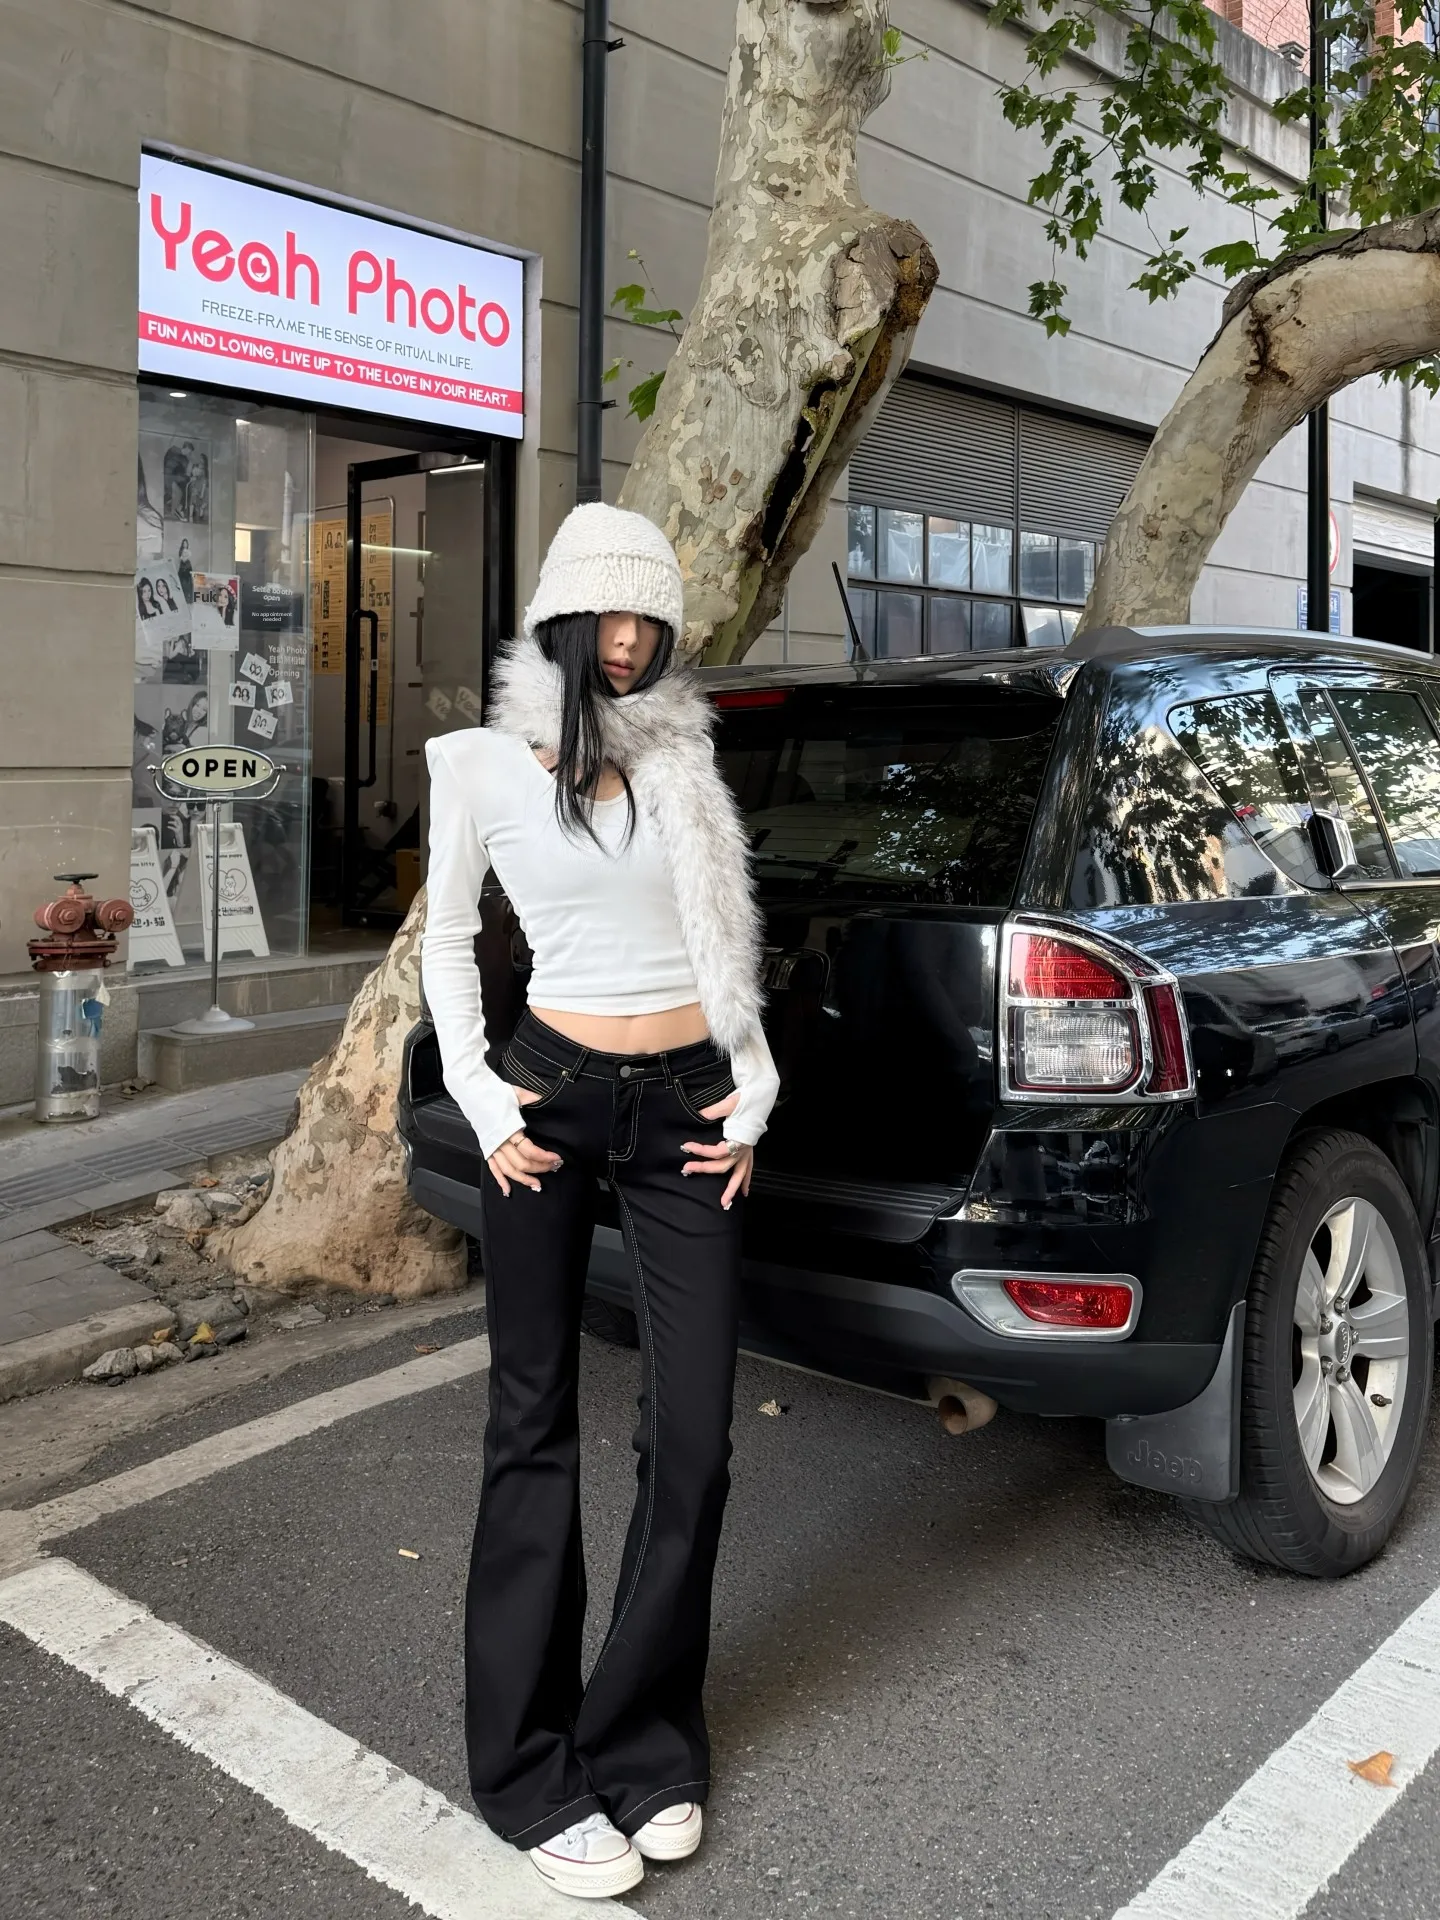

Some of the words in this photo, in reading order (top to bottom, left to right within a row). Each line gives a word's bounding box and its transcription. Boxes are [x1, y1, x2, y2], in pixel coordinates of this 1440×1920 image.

[150, 193, 320, 306] Yeah
[348, 250, 510, 347] Photo
[202, 299, 306, 335] FREEZE-FRAME
[308, 323, 332, 340] THE
[334, 329, 373, 349] SENSE
[375, 339, 392, 352] OF
[394, 342, 435, 362] RITUAL
[437, 351, 447, 365] IN
[449, 354, 473, 371] LIFE.
[147, 320, 177, 340] FUN
[181, 329, 215, 348] AND
[219, 336, 279, 363] LOVING,
[282, 349, 311, 368] LIVE
[313, 355, 331, 370] UP
[334, 360, 354, 376] TO
[357, 365, 382, 382] THE
[384, 370, 417, 389] LOVE
[420, 377, 432, 392] IN
[434, 381, 467, 399] YOUR
[469, 387, 512, 407] HEART.
[268, 645, 285, 653] Yeah
[286, 646, 307, 655] Photo
[268, 668, 300, 679] Opening
[181, 757, 257, 778] OPEN
[1127, 1438, 1204, 1485] Jeep
